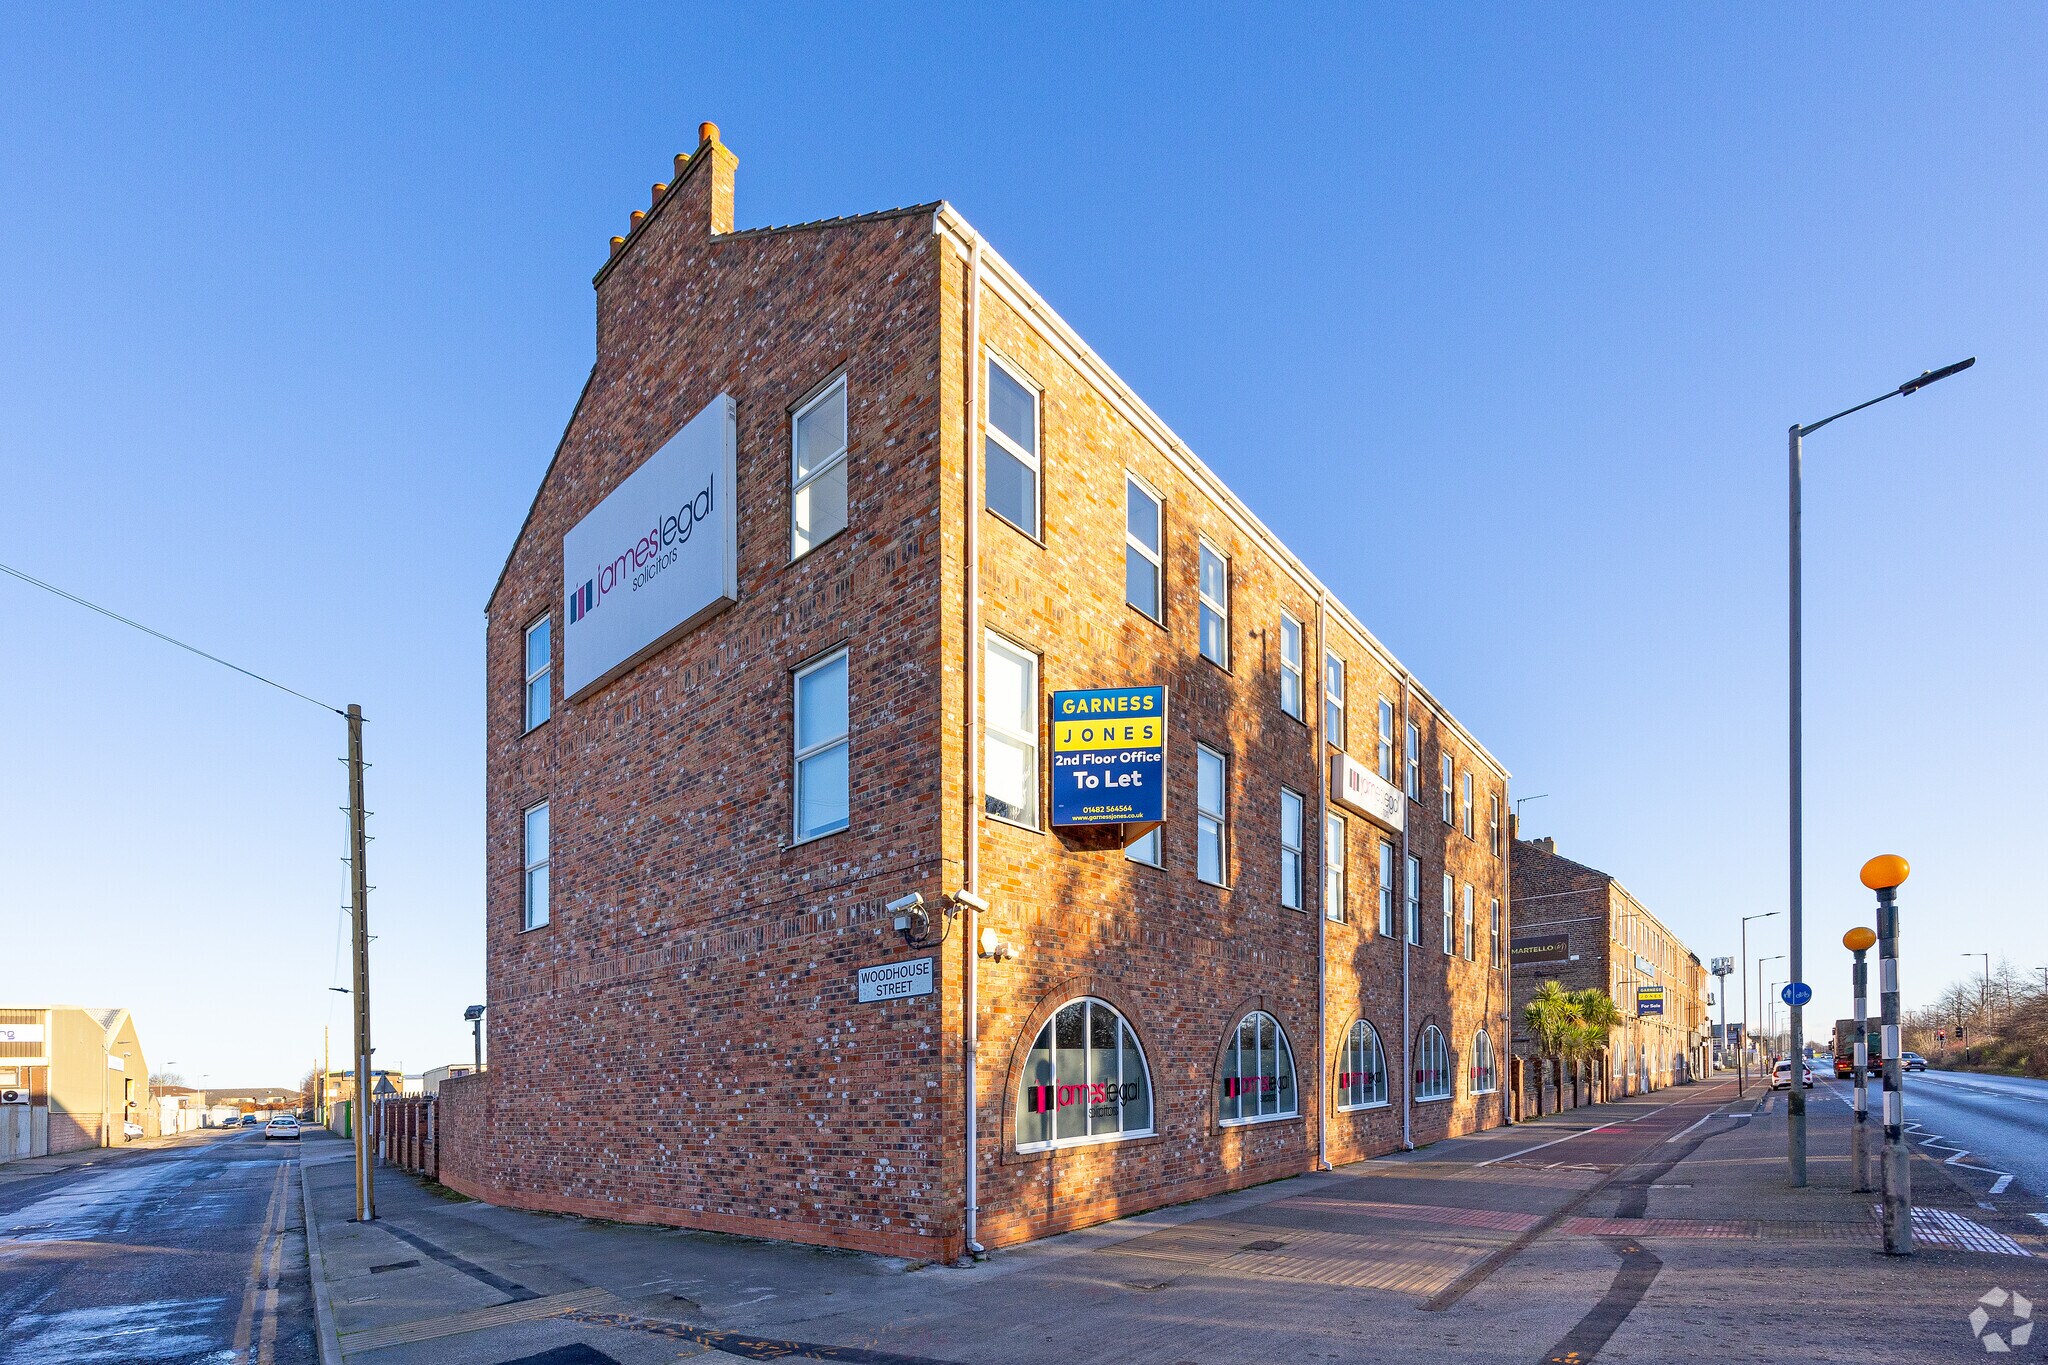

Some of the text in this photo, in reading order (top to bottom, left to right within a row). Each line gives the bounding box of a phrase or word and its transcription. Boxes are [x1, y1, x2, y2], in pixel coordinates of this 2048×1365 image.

[597, 471, 714, 607] jameslegal
[632, 547, 678, 592] solicitors
[1062, 695, 1154, 714] GARNESS
[1063, 725, 1153, 743] JONES
[1055, 751, 1161, 766] 2nd Floor Office
[1073, 770, 1143, 789] To Let
[1072, 811, 1144, 821] www.garnessjones.co.uk
[1082, 804, 1133, 814] 01482 564564
[1511, 945, 1554, 955] MARTELLO
[861, 962, 930, 984] WOODHOUSE
[876, 980, 913, 997] STREET
[1056, 1077, 1140, 1112] jameslegal
